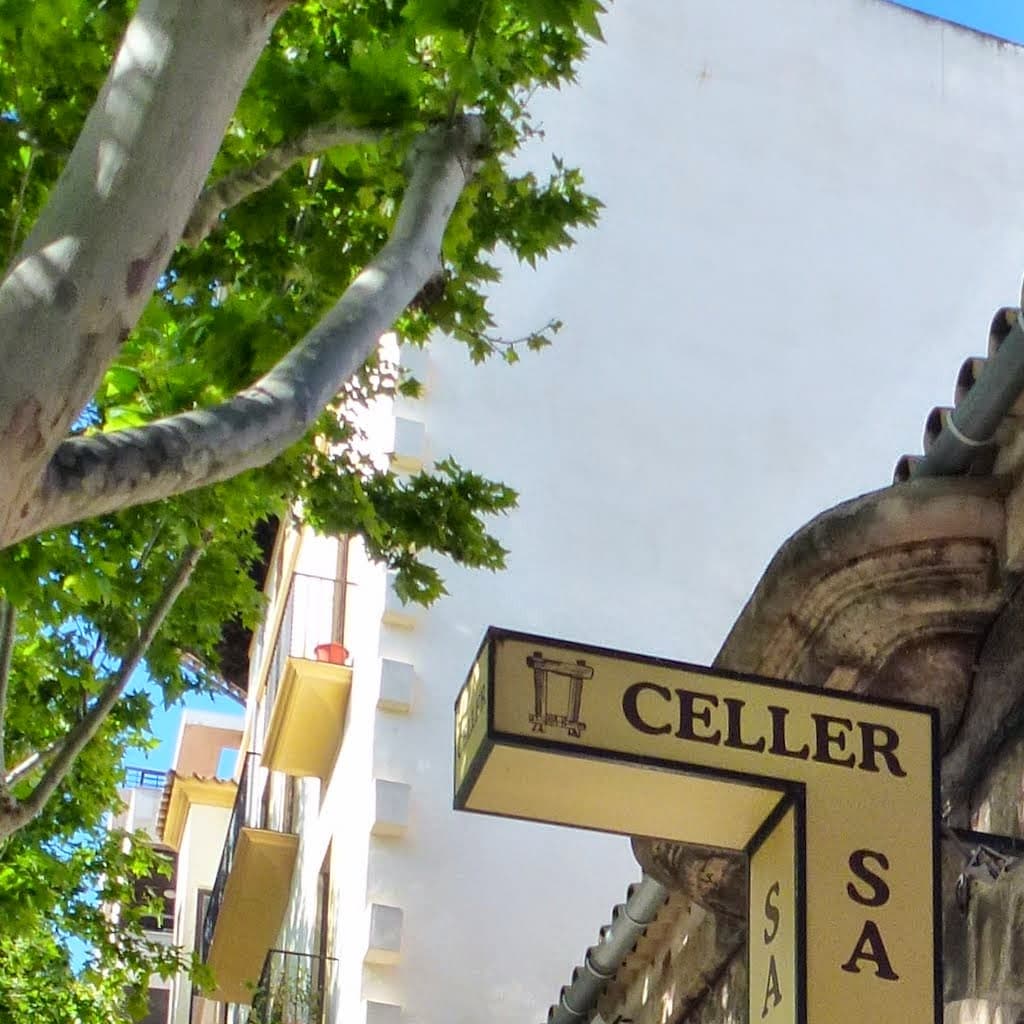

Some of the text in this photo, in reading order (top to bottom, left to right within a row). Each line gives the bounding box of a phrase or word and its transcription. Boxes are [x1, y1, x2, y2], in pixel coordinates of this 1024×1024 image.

[622, 682, 907, 777] CELLER
[762, 880, 783, 1018] SA
[841, 849, 899, 981] SA
